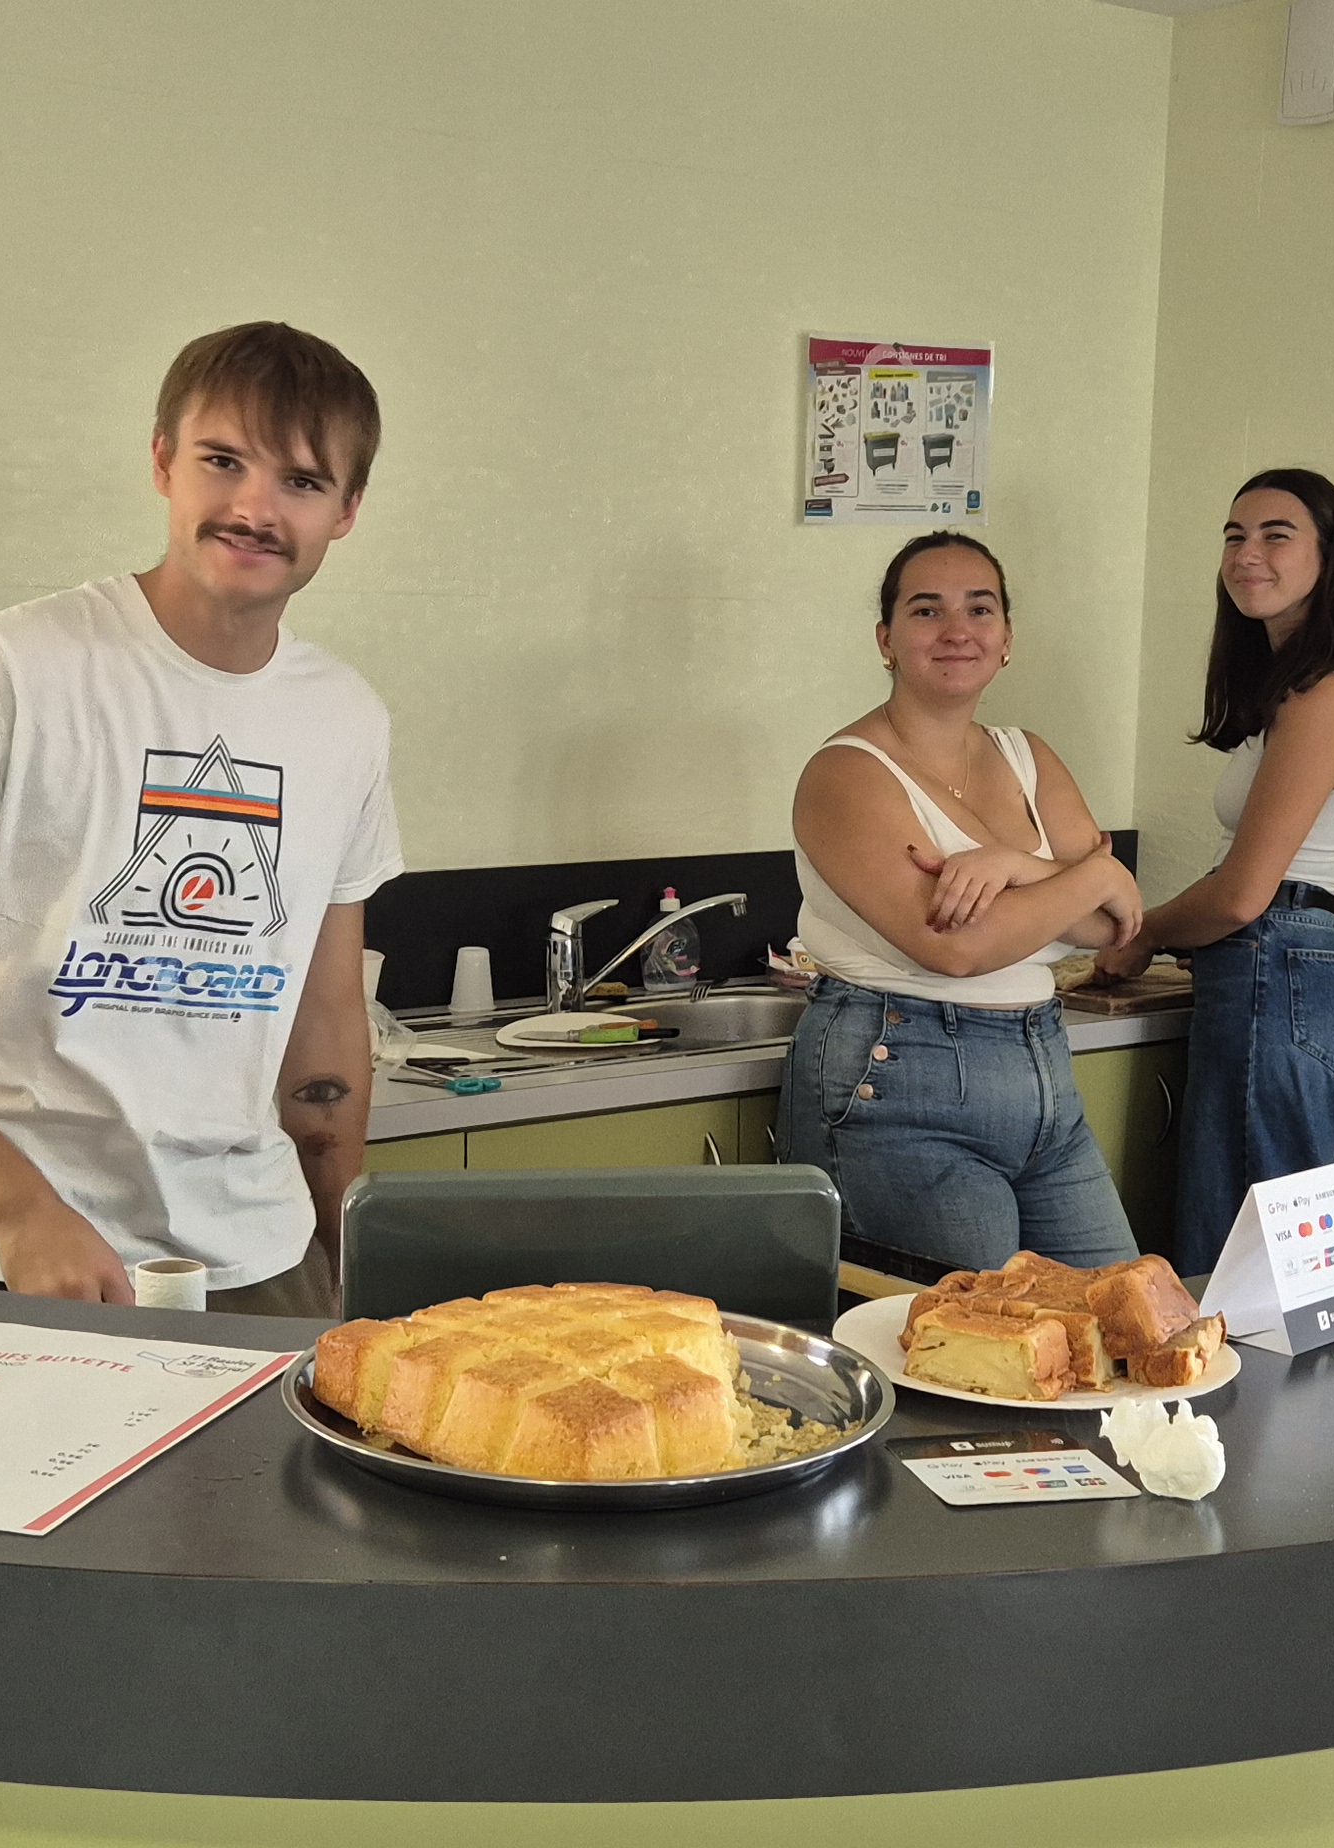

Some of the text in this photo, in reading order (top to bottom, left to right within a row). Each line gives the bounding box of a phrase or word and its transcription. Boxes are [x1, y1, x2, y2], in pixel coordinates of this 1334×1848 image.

[924, 353, 934, 361] DE
[935, 353, 947, 361] TRI
[92, 1002, 129, 1012] ORIGINAL
[131, 1005, 153, 1013] SURF
[154, 1008, 185, 1017] BRAND
[1275, 1230, 1293, 1241] VISA
[36, 1355, 135, 1373] BUVETTE
